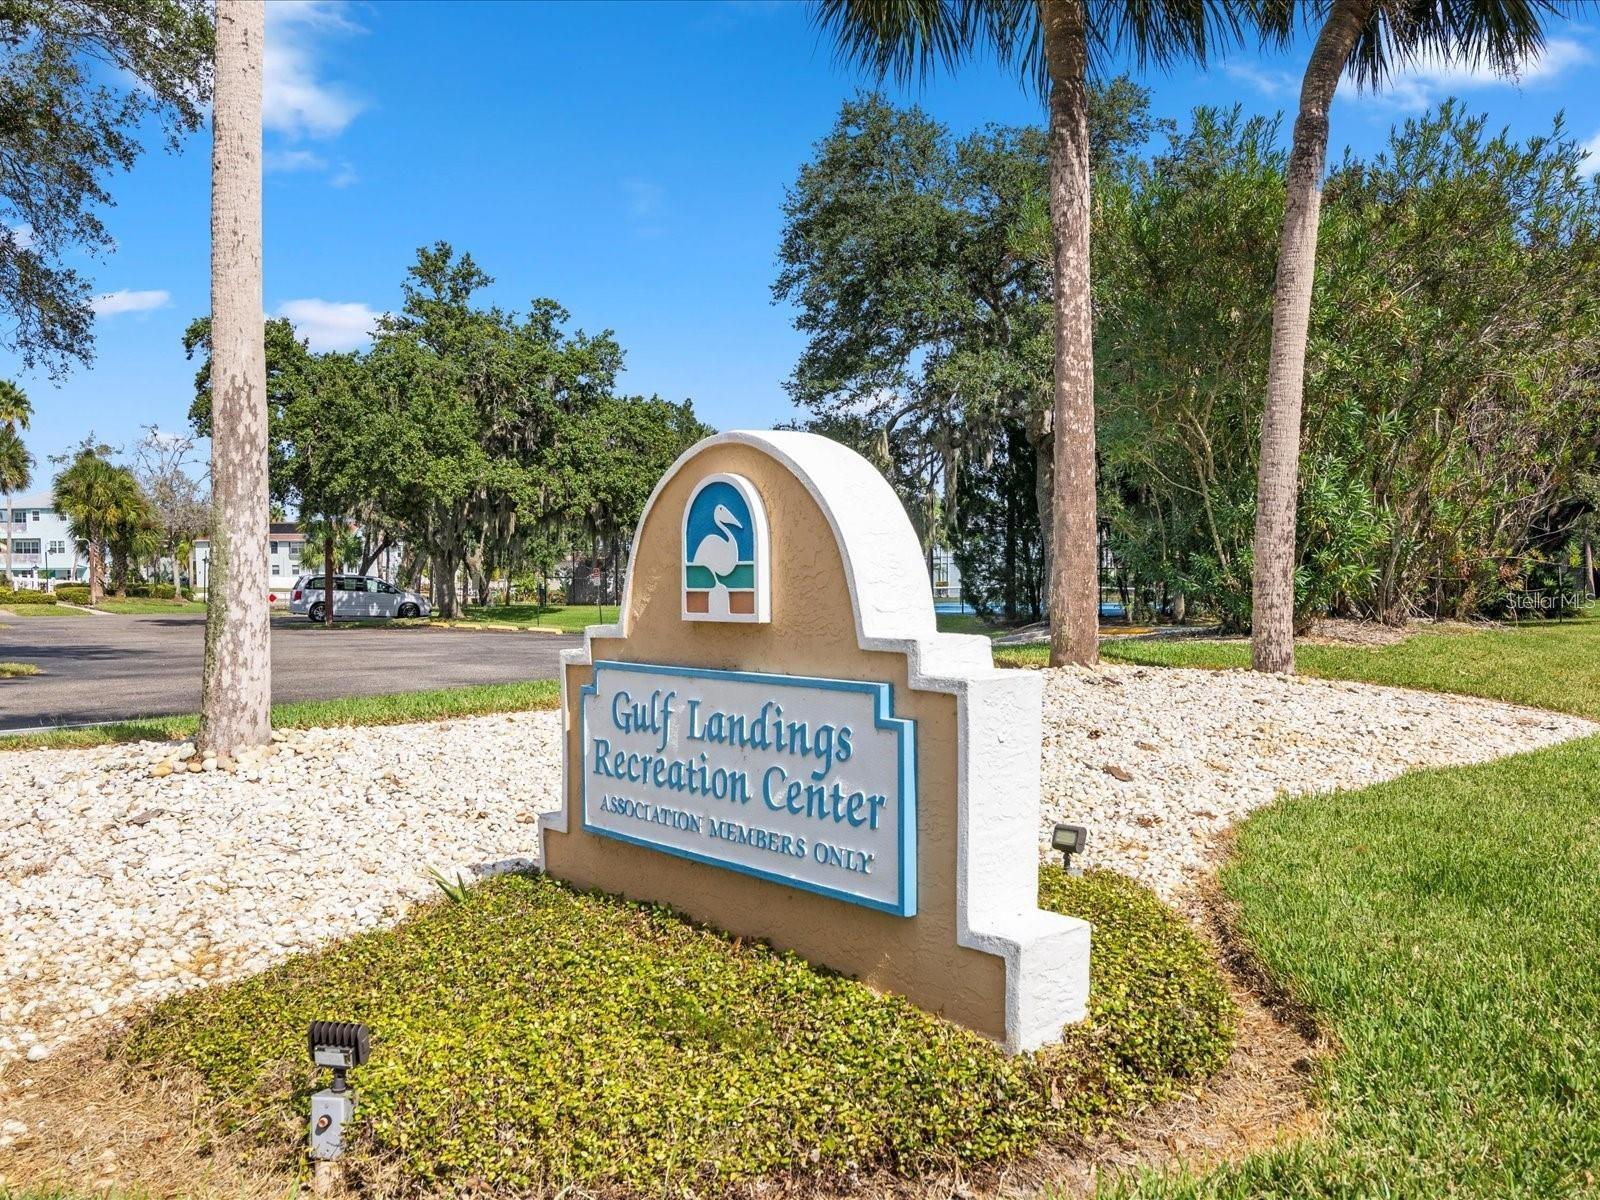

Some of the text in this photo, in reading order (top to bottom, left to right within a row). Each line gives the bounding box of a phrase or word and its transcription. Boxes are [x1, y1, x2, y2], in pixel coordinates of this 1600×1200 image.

[612, 689, 853, 781] Gulf Landings
[593, 738, 886, 830] Recreation Center
[600, 794, 875, 874] ASSOCIATION MEMBERS ONLY
